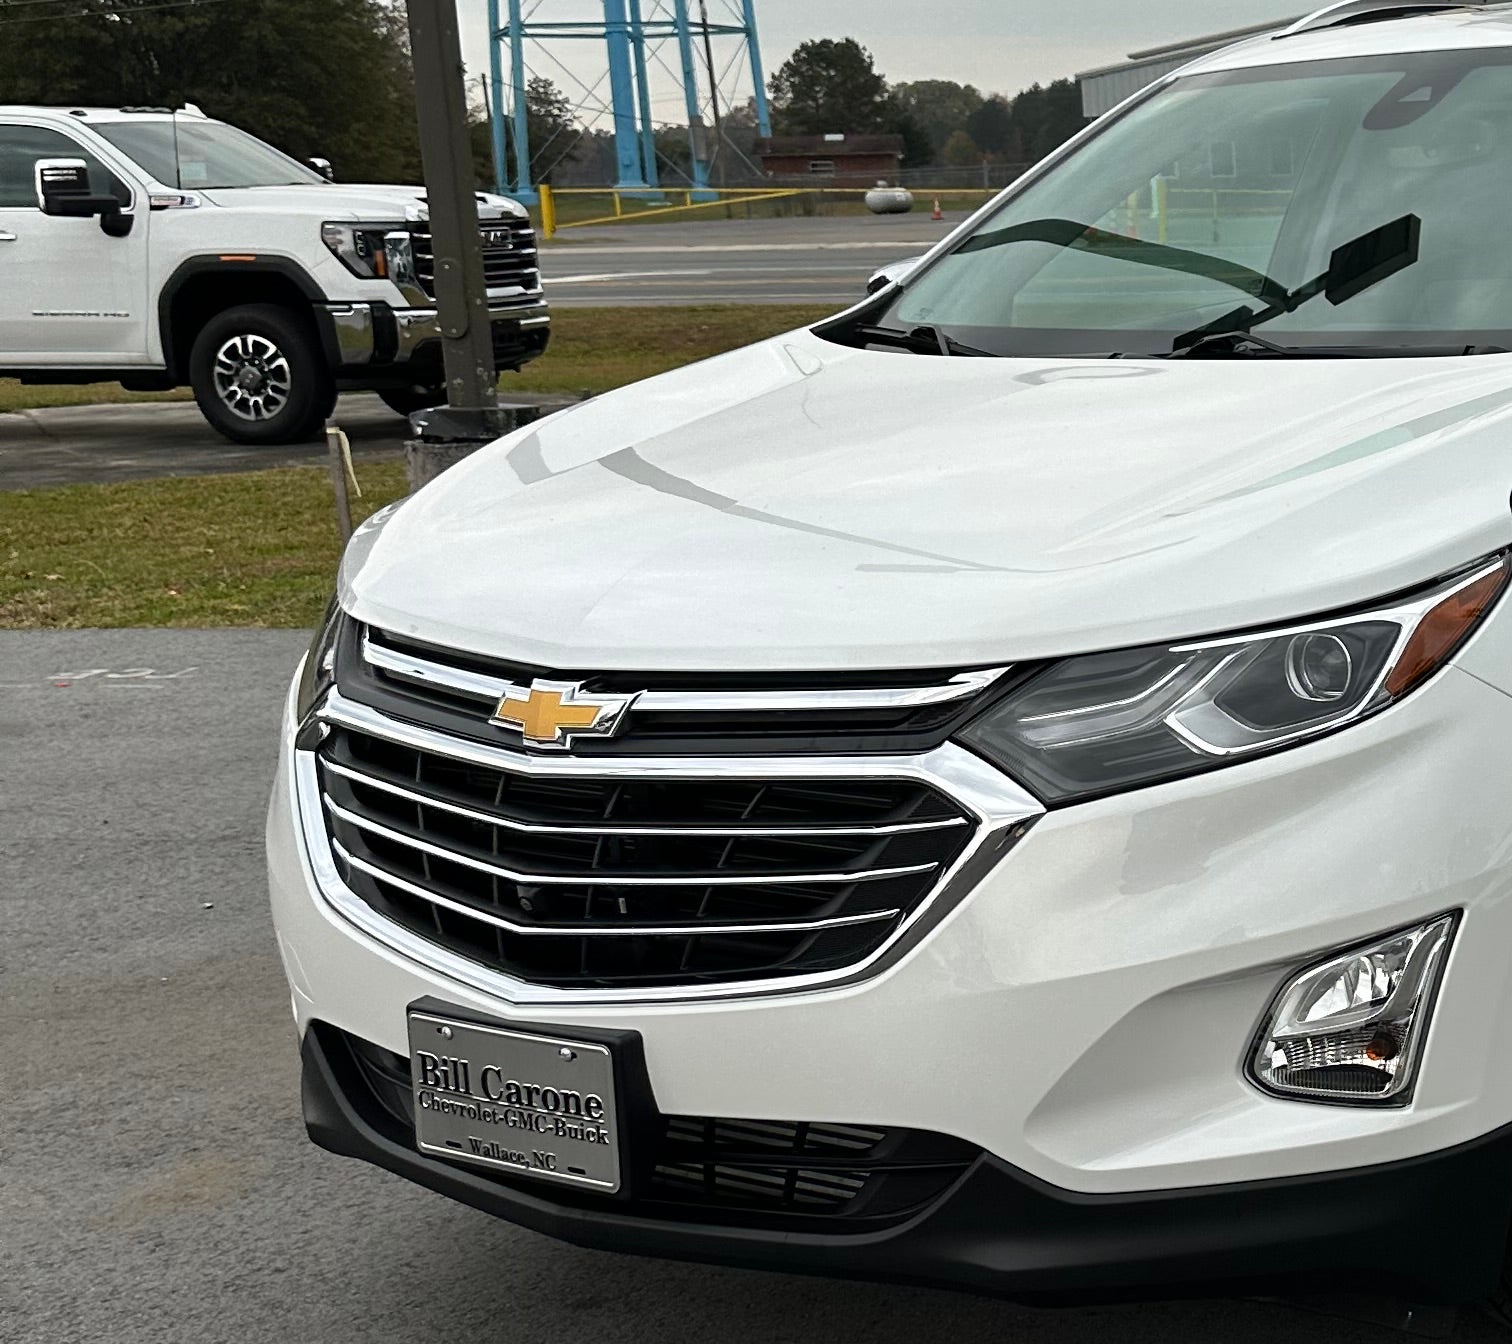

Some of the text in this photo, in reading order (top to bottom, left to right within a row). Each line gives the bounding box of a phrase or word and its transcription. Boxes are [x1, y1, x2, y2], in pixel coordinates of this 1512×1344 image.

[416, 1050, 604, 1119] Bill Carone
[417, 1090, 610, 1146] Chevrolet-GMC-Buick
[468, 1136, 557, 1171] Wallace, NC
